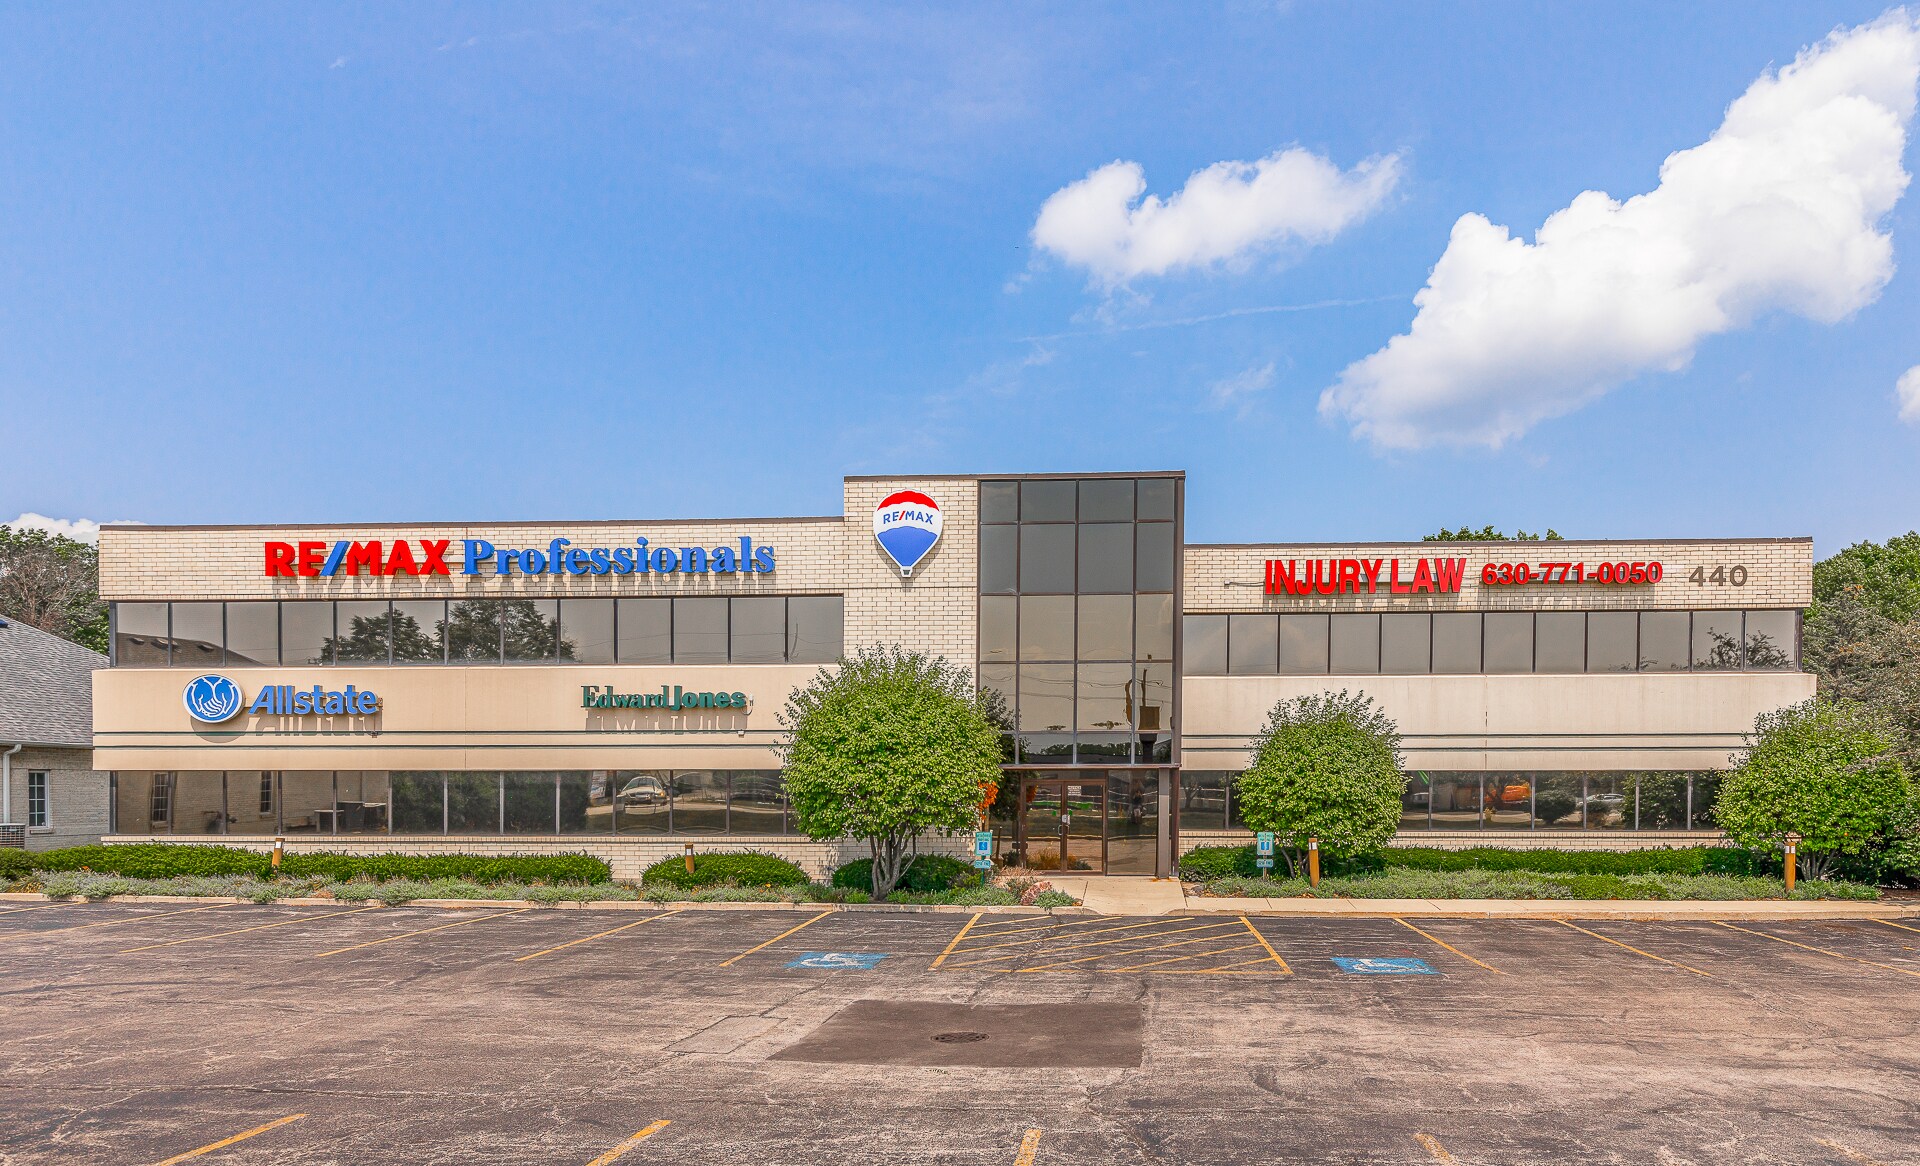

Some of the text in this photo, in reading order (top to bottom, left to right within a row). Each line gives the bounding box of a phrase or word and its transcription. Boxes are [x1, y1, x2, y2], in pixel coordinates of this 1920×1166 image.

[882, 510, 933, 525] RE/MAX
[264, 536, 776, 577] RE/MAX Professionals
[1264, 557, 1467, 595] INJURY LAW
[1481, 561, 1663, 585] 630-771-0050
[1689, 565, 1748, 587] 440
[248, 685, 378, 715] Allstate
